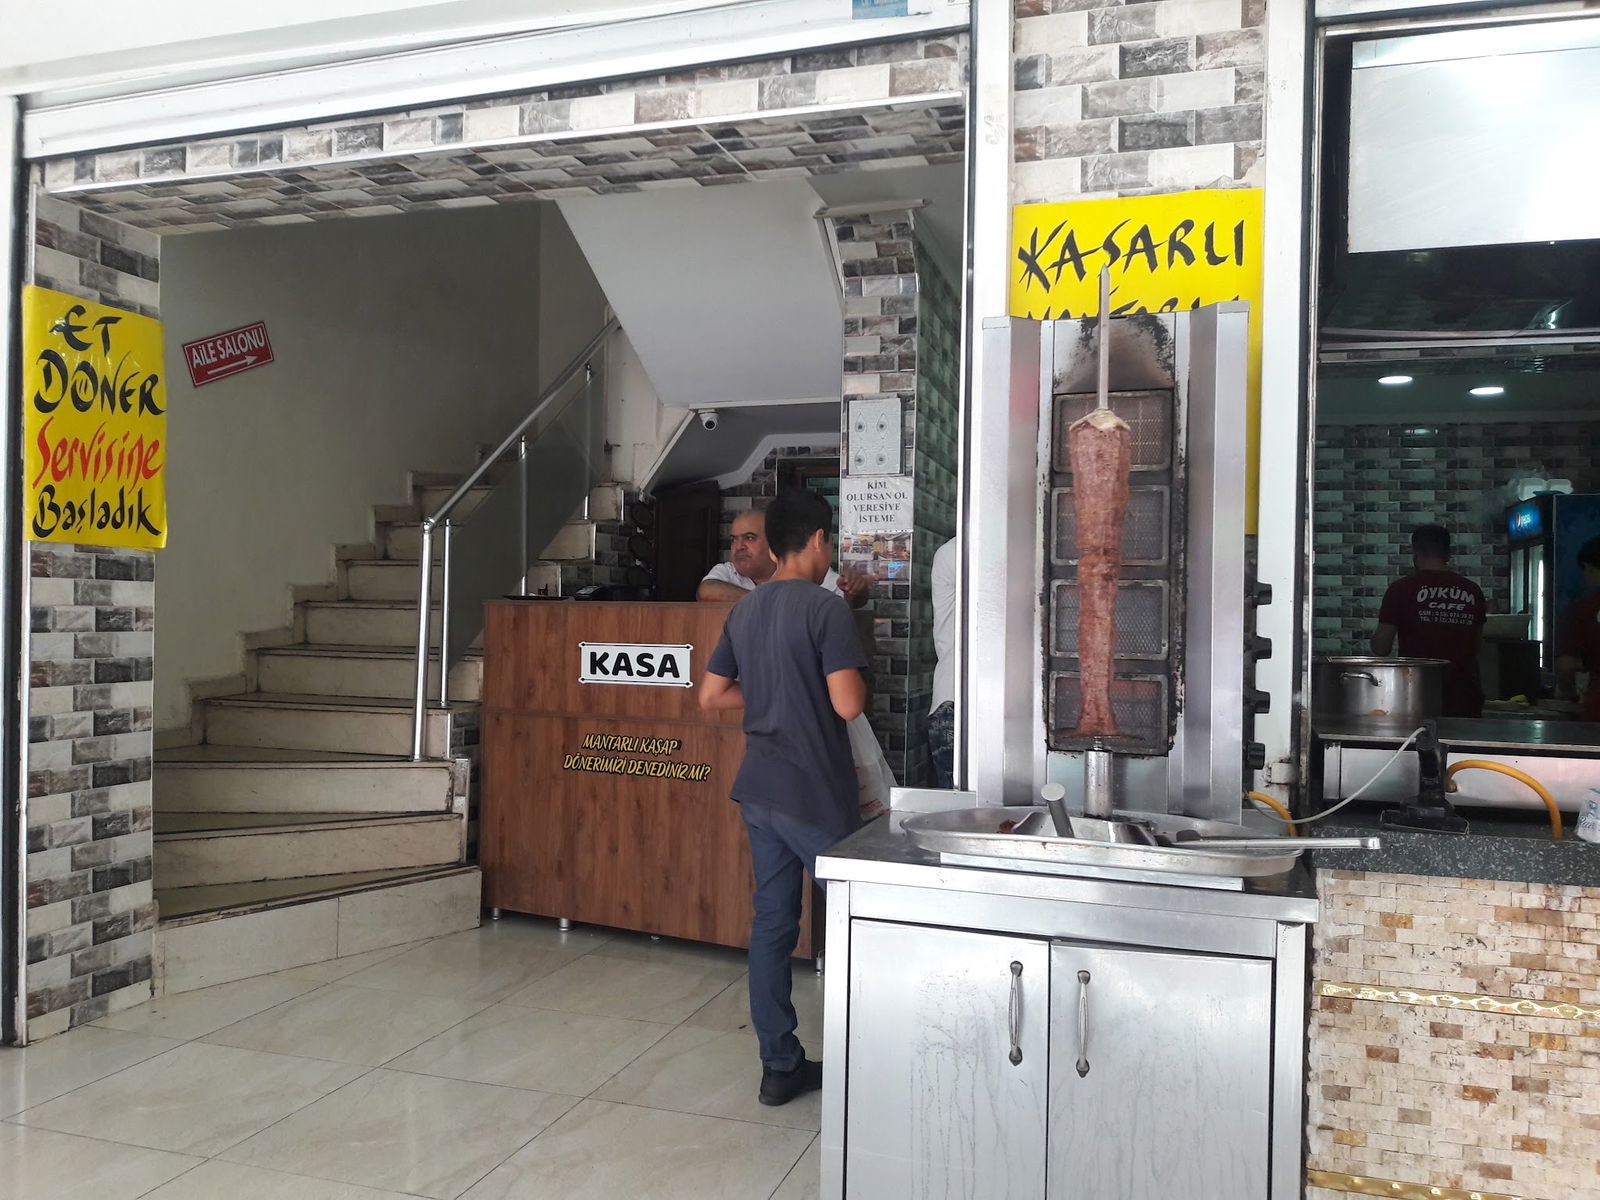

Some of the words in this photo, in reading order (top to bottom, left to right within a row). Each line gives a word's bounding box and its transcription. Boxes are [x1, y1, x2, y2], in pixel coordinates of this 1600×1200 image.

[49, 304, 123, 357] ET
[216, 327, 265, 360] SALONU
[33, 348, 167, 418] DÖNER
[32, 416, 164, 494] Servisine
[32, 484, 162, 538] Başladık
[847, 491, 892, 501] OLURSAN
[895, 491, 908, 499] OL
[1416, 585, 1476, 606] ÖYKÜM
[1428, 602, 1466, 611] CAFE
[590, 651, 680, 678] KASA
[582, 734, 639, 752] MANTARLI
